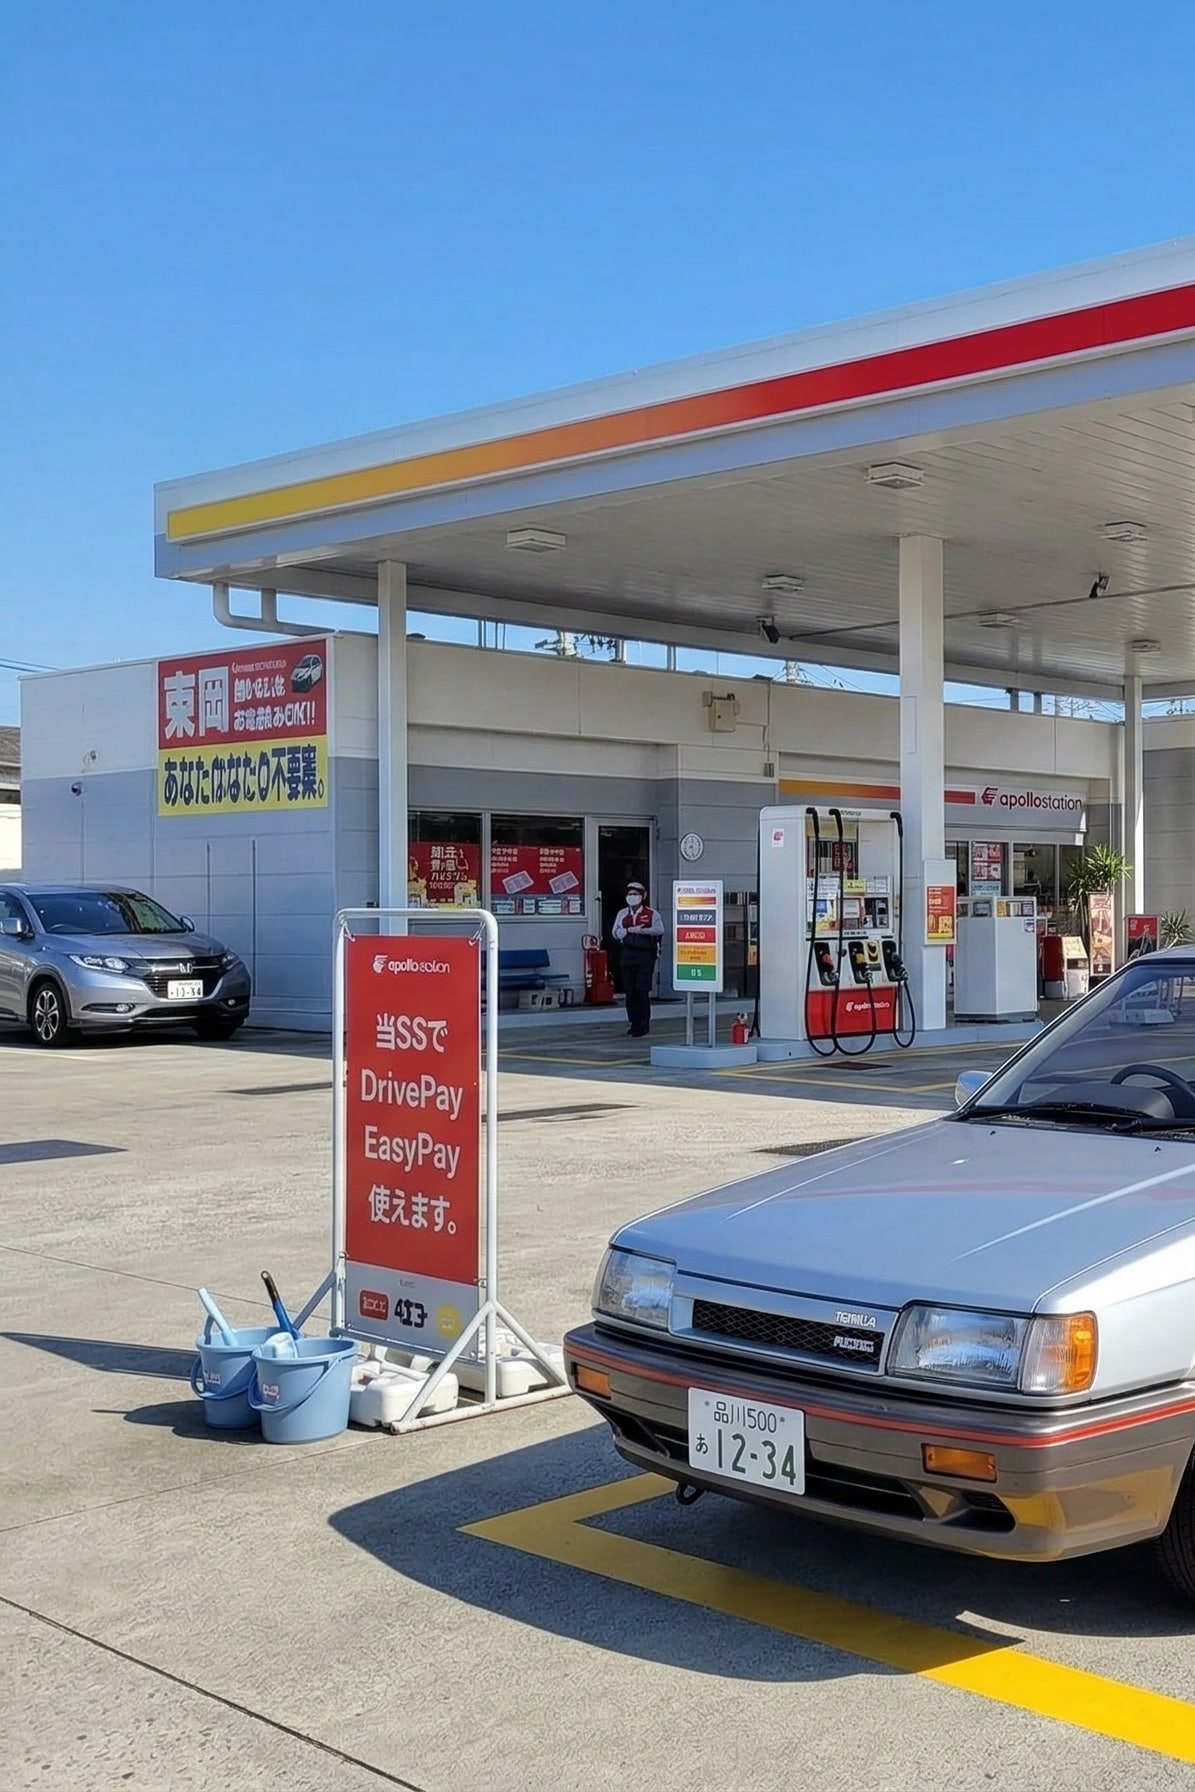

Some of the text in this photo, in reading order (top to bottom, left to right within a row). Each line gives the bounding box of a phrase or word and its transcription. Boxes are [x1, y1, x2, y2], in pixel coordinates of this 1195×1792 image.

[999, 791, 1083, 811] apollostation
[376, 1012, 448, 1054] 当SSで
[361, 1068, 463, 1121] DrivePay
[364, 1124, 461, 1180] EasyPay
[368, 1183, 457, 1236] 使えます。
[713, 1400, 777, 1434] 品川500
[695, 1428, 797, 1486] あ 12-34
